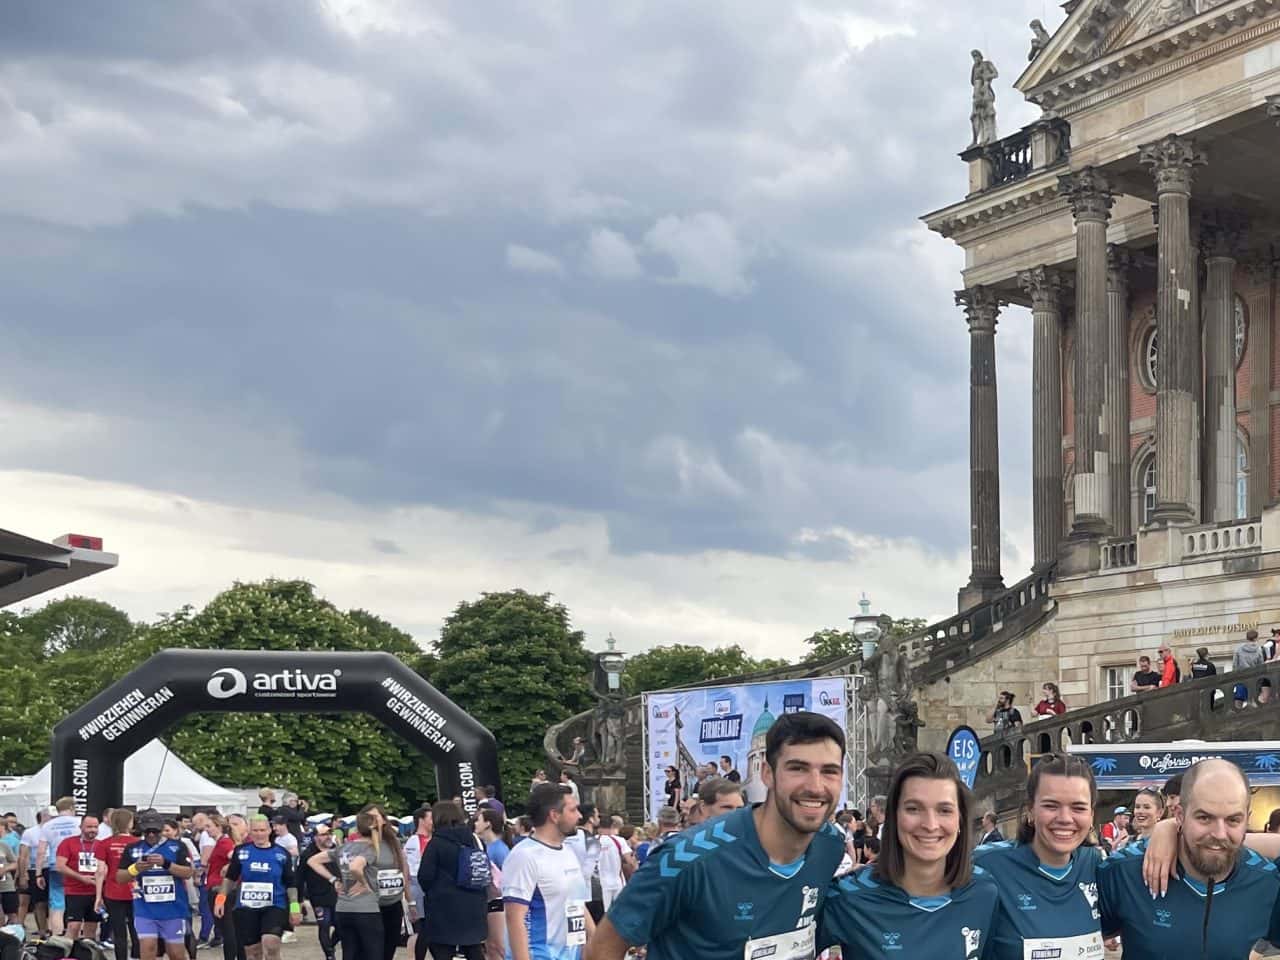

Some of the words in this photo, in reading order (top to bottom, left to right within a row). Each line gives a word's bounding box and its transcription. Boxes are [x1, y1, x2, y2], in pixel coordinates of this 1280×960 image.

[253, 669, 337, 691] artiva
[381, 677, 447, 729] #WIRZIEHEN
[79, 688, 146, 742] #WIRZIEHEN
[102, 686, 175, 742] GEWINNERAN
[386, 697, 456, 753] GEWINNERAN
[953, 739, 975, 760] EIS
[1151, 753, 1192, 774] California
